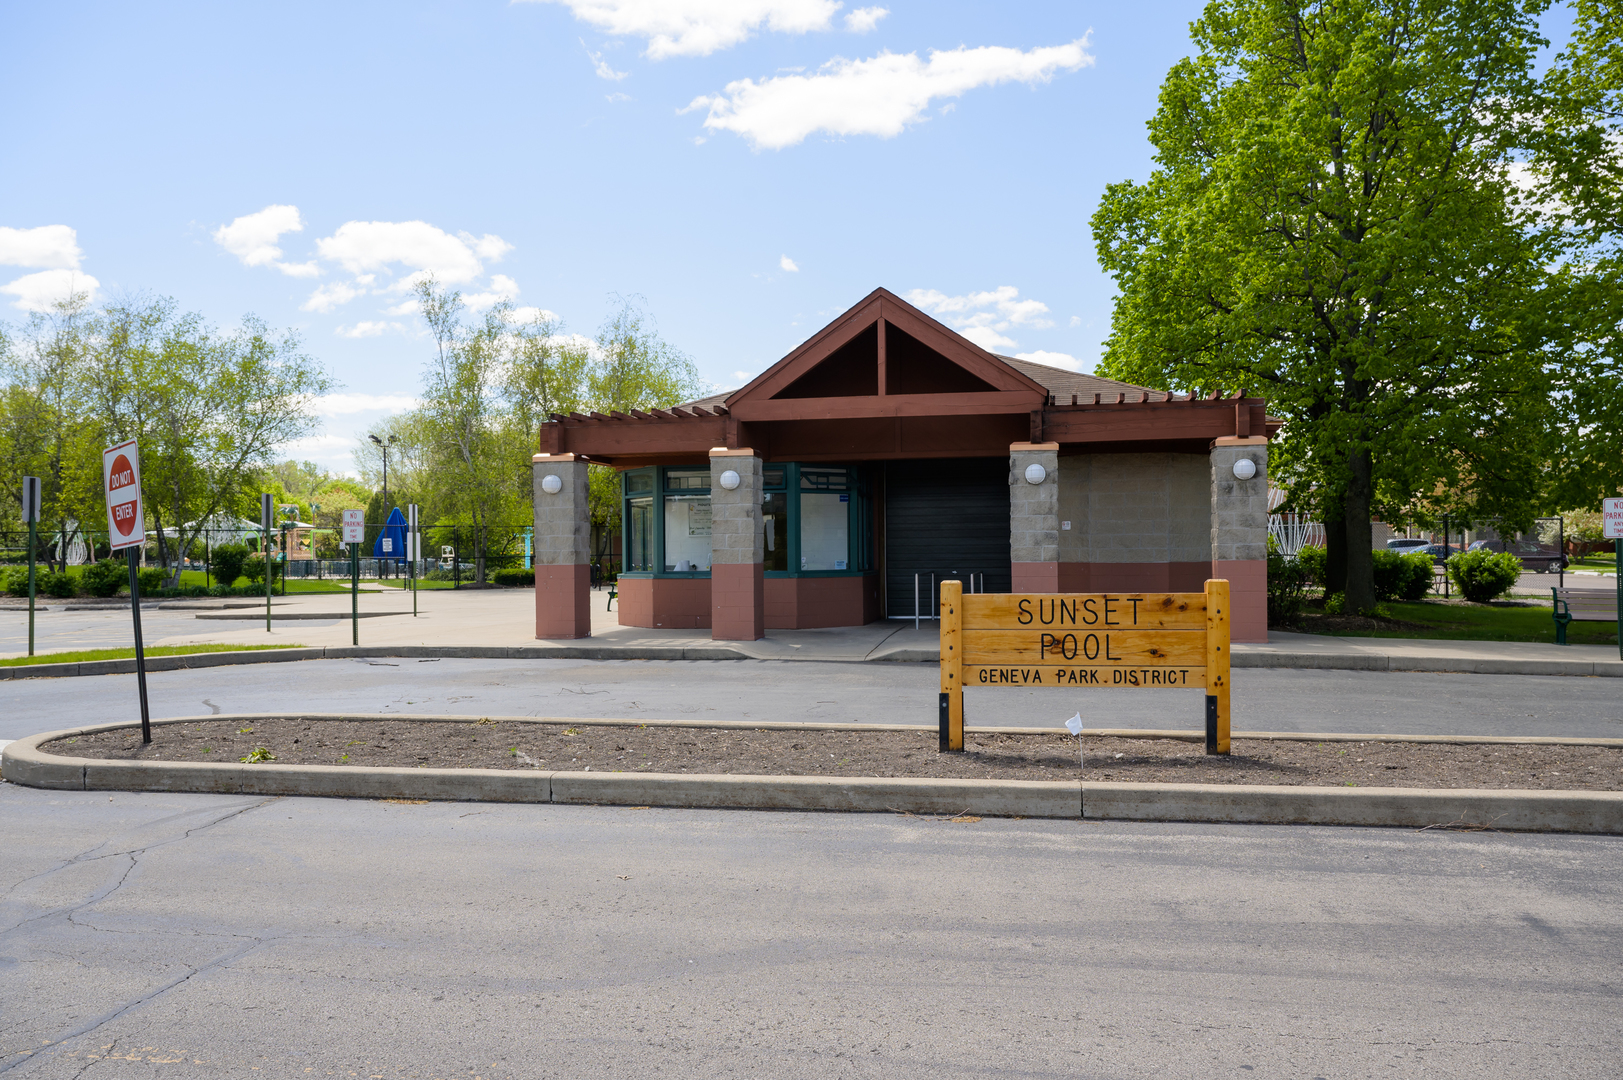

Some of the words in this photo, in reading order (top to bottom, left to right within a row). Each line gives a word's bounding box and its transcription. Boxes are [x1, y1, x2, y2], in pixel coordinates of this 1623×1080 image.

[111, 474, 120, 488] DO
[120, 471, 130, 486] NOT
[116, 504, 133, 520] ENTER
[1017, 598, 1144, 625] SUNSET
[1040, 633, 1122, 660] POOL
[979, 669, 1042, 683] GENEVA
[1057, 669, 1099, 684] PARK
[1113, 670, 1189, 685] DISTRICT
